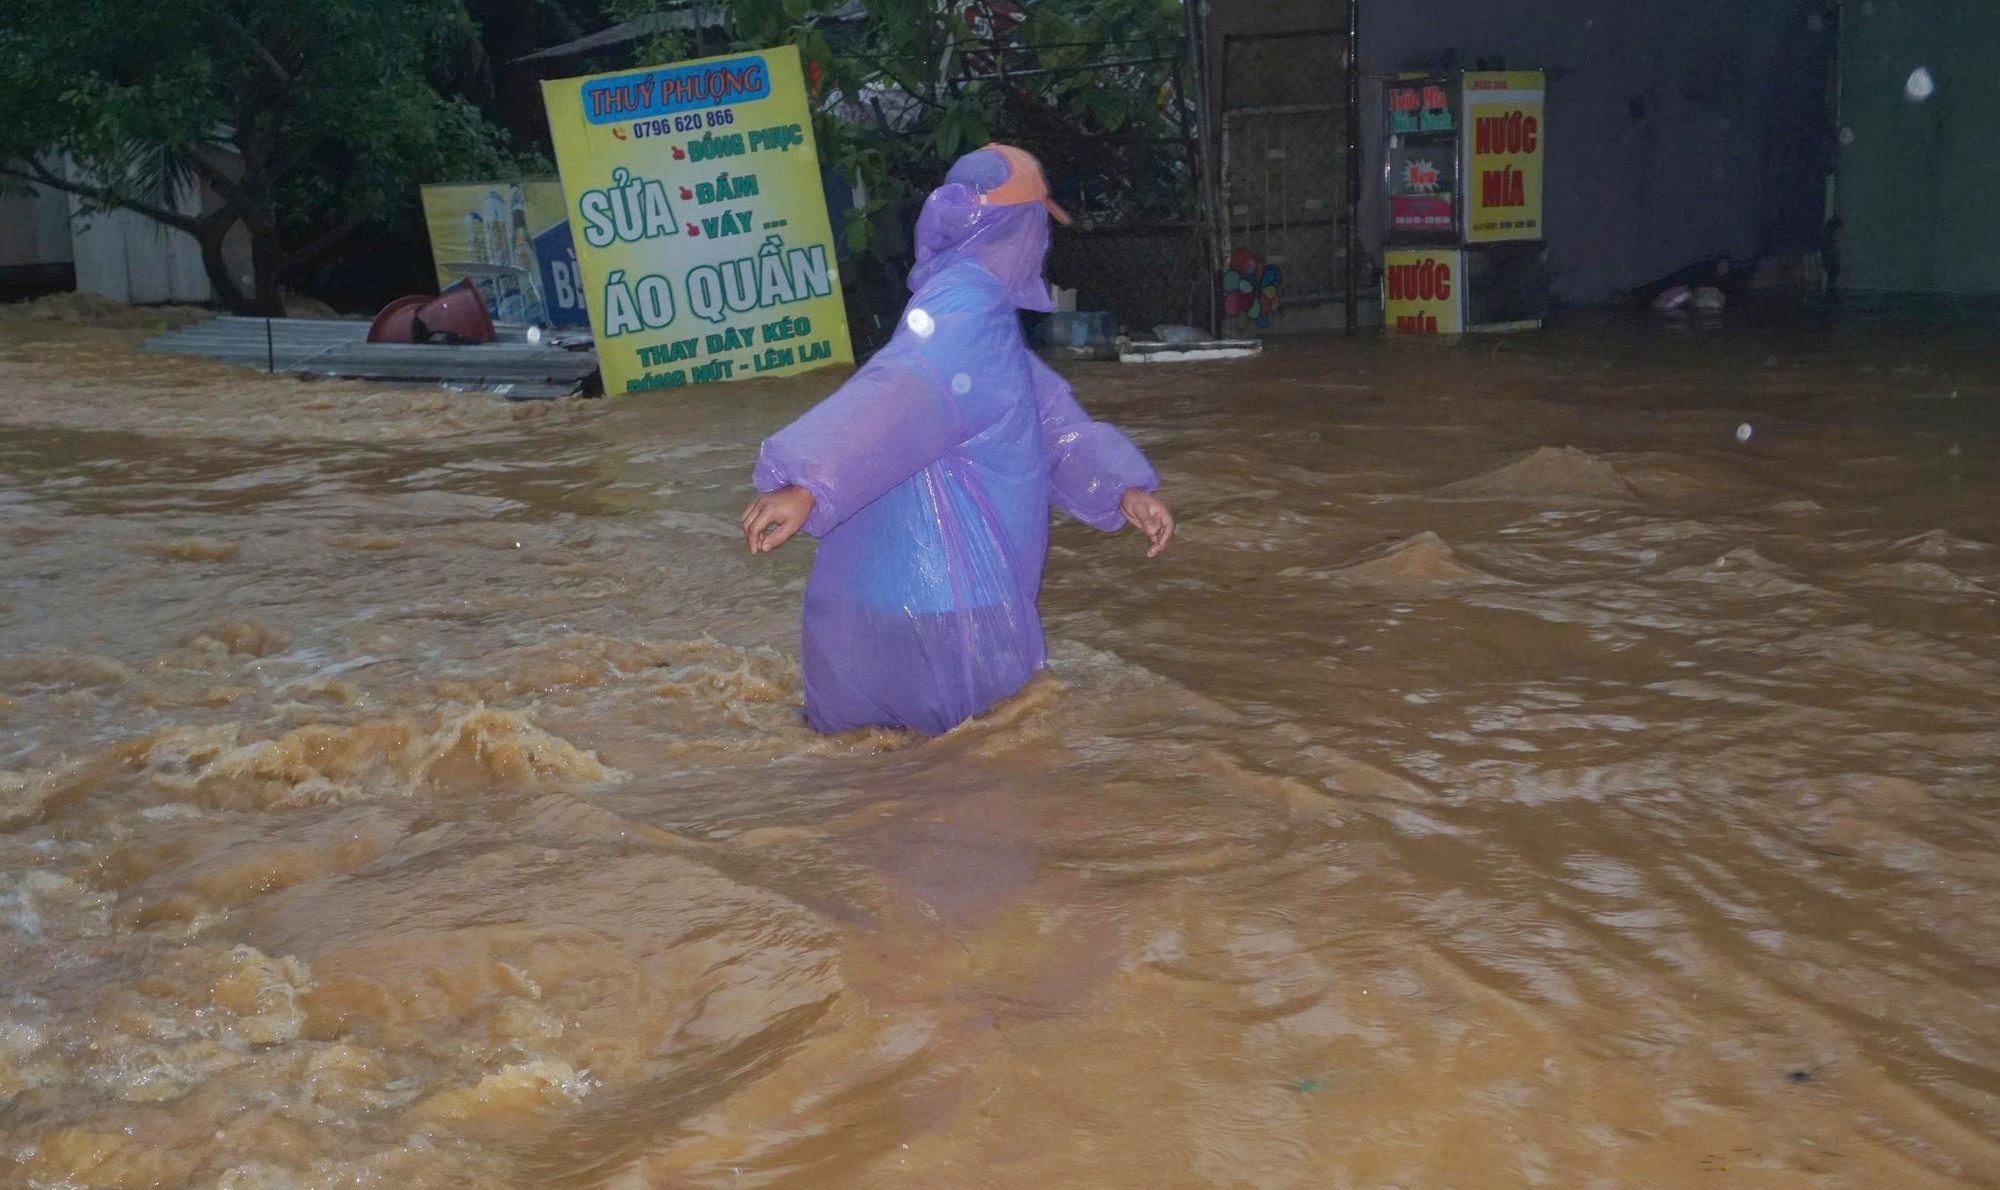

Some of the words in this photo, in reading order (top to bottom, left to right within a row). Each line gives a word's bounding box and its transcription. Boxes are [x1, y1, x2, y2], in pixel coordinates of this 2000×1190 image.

[590, 74, 655, 116] THUÝ
[661, 64, 763, 105] PHƯỢNG
[633, 120, 671, 139] 0796
[675, 114, 702, 133] 620
[707, 108, 734, 127] 866
[748, 123, 804, 153] PHỤC
[1475, 110, 1538, 155] NƯỚC
[579, 166, 679, 248] SỬA
[1482, 164, 1525, 208] MÍA
[701, 210, 753, 239] VÁY
[604, 269, 676, 338] ÁO
[686, 234, 832, 323] QUẦN
[1388, 258, 1451, 301] NƯỚC
[636, 337, 699, 368] THAY
[705, 326, 755, 355] DÂY
[761, 316, 811, 344] KÉO
[692, 357, 734, 385] NÚT
[754, 348, 795, 373] LÊN
